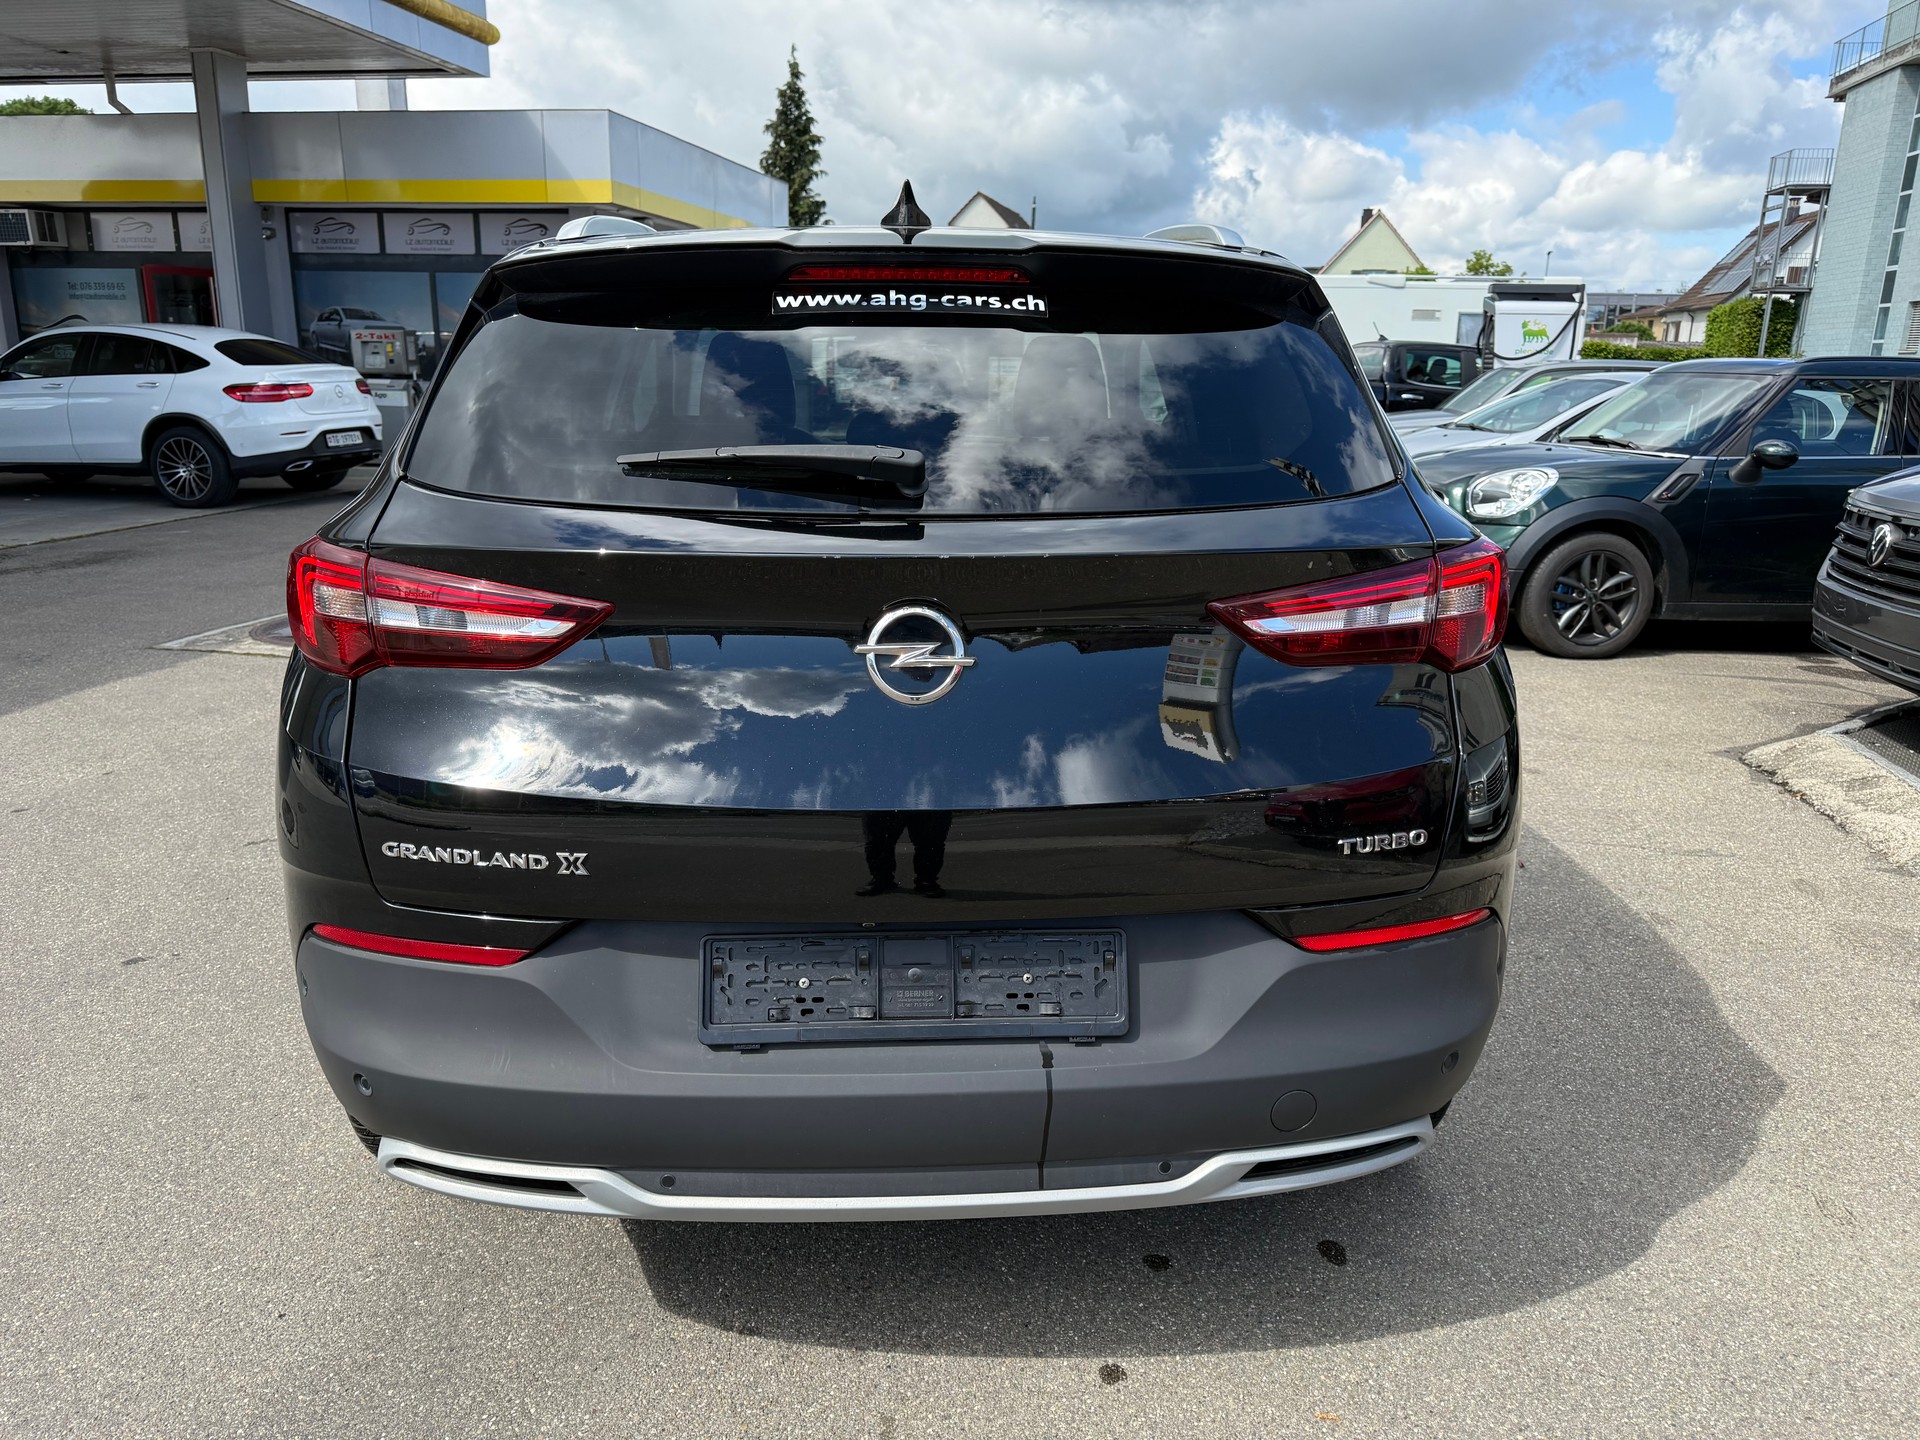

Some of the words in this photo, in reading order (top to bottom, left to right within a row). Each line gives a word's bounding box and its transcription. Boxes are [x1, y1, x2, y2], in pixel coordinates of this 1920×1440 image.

[79, 282, 92, 291] 076
[93, 282, 105, 291] 339
[775, 290, 1046, 312] www.ahg-cars.ch
[355, 332, 397, 340] 2-Takt
[1337, 828, 1429, 855] TURBO
[381, 841, 550, 871] GRANDLAND
[555, 851, 591, 876] X
[904, 990, 935, 998] BERNER
